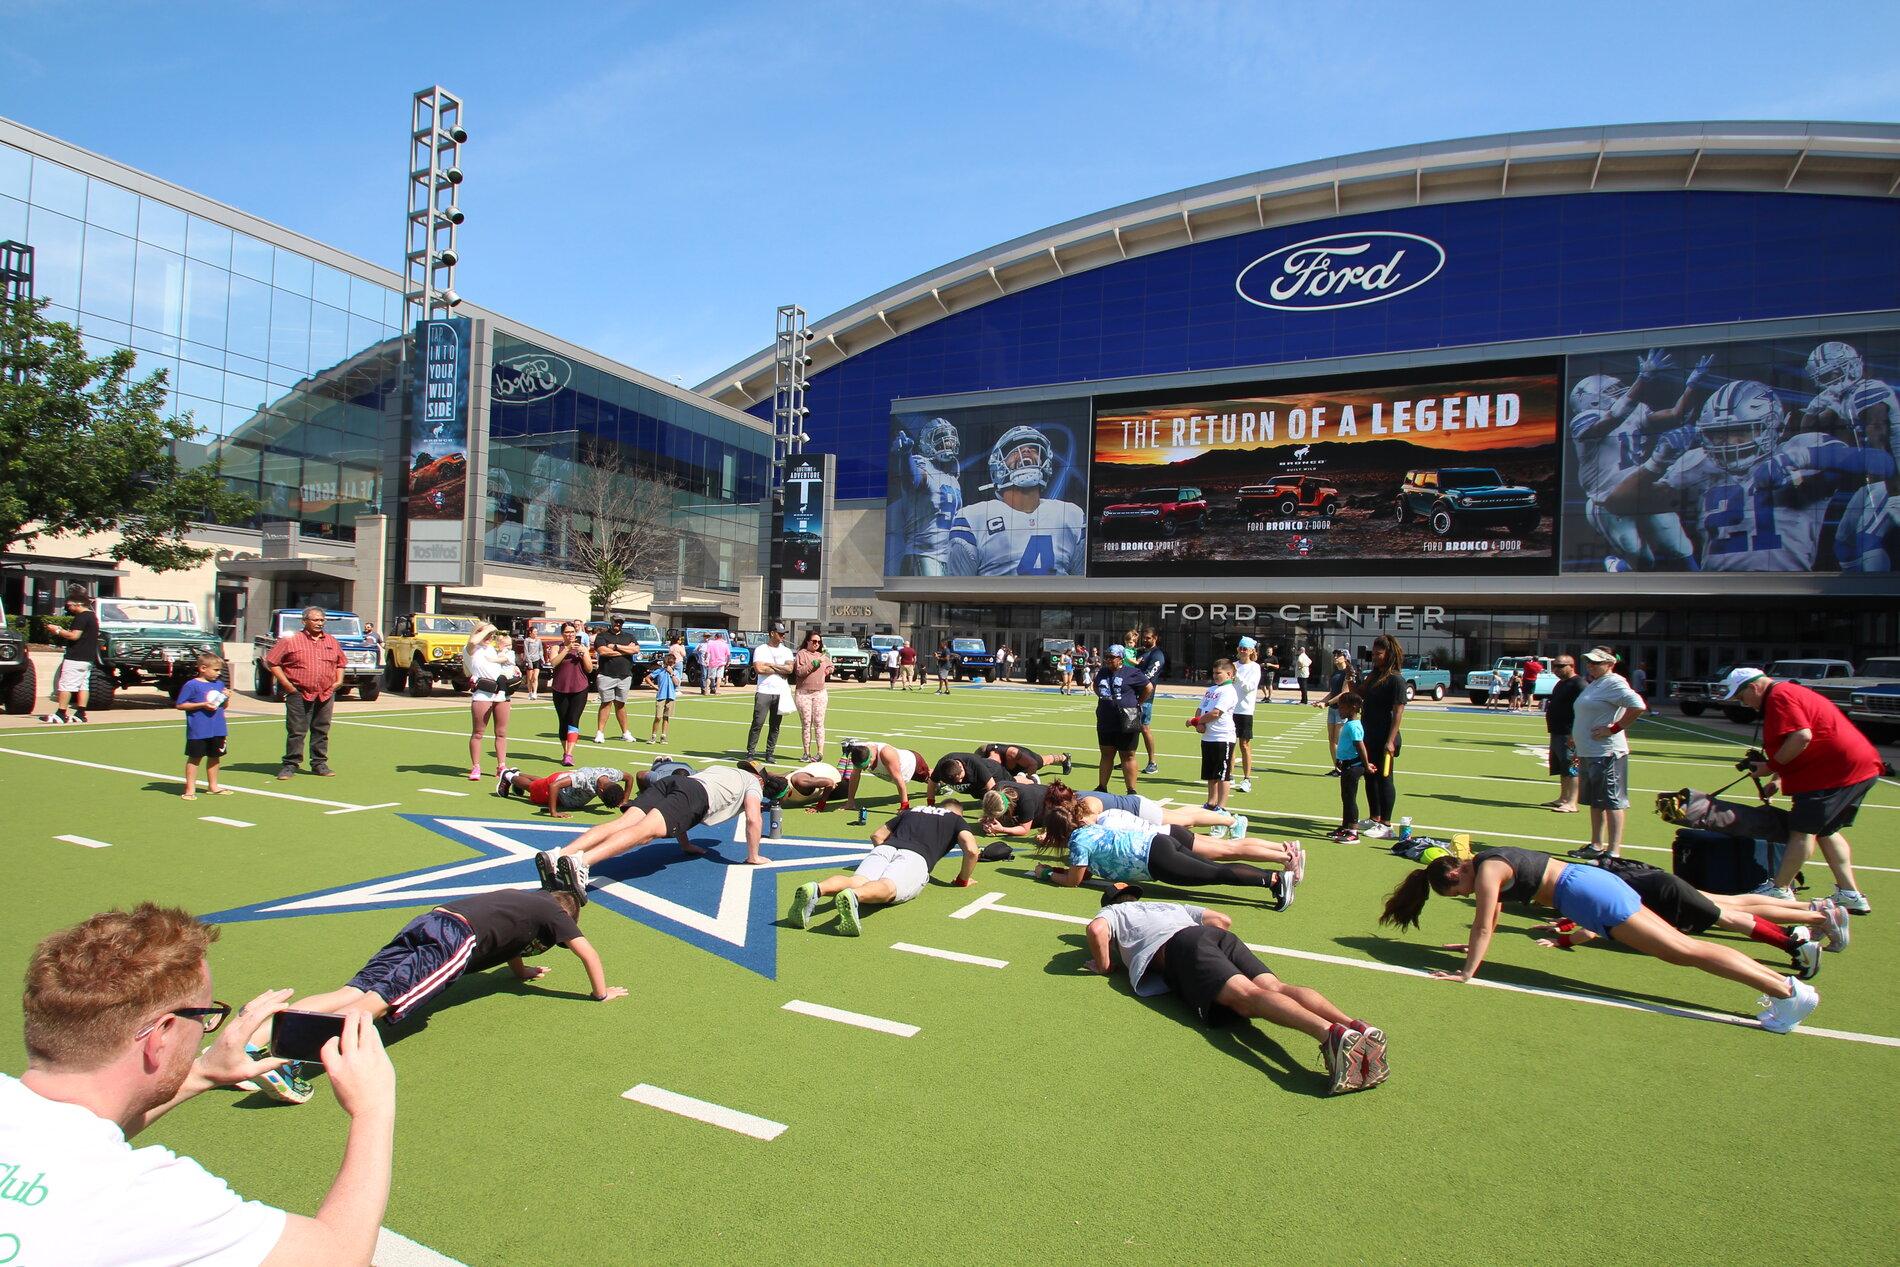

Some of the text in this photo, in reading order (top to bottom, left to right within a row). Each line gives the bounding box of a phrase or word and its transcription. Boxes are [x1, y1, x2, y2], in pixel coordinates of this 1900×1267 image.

[1270, 243, 1405, 300] Ford
[431, 327, 443, 342] TAP
[430, 344, 455, 360] INTO
[429, 363, 453, 379] YOUR
[428, 383, 453, 398] WILD
[428, 401, 452, 417] SIDE
[1121, 393, 1520, 449] THE RETURN OF A LEGEND
[988, 517, 1003, 531] C
[1247, 520, 1331, 531] FORD BRONCO 2-DOOR
[1704, 485, 1782, 554] 21
[1104, 543, 1119, 551] FORD
[1121, 541, 1153, 550] BRONCO
[1423, 540, 1521, 551] FORD BRONCO 4-DOOR
[1017, 535, 1057, 575] 4
[1161, 603, 1445, 624] FORD CENTER
